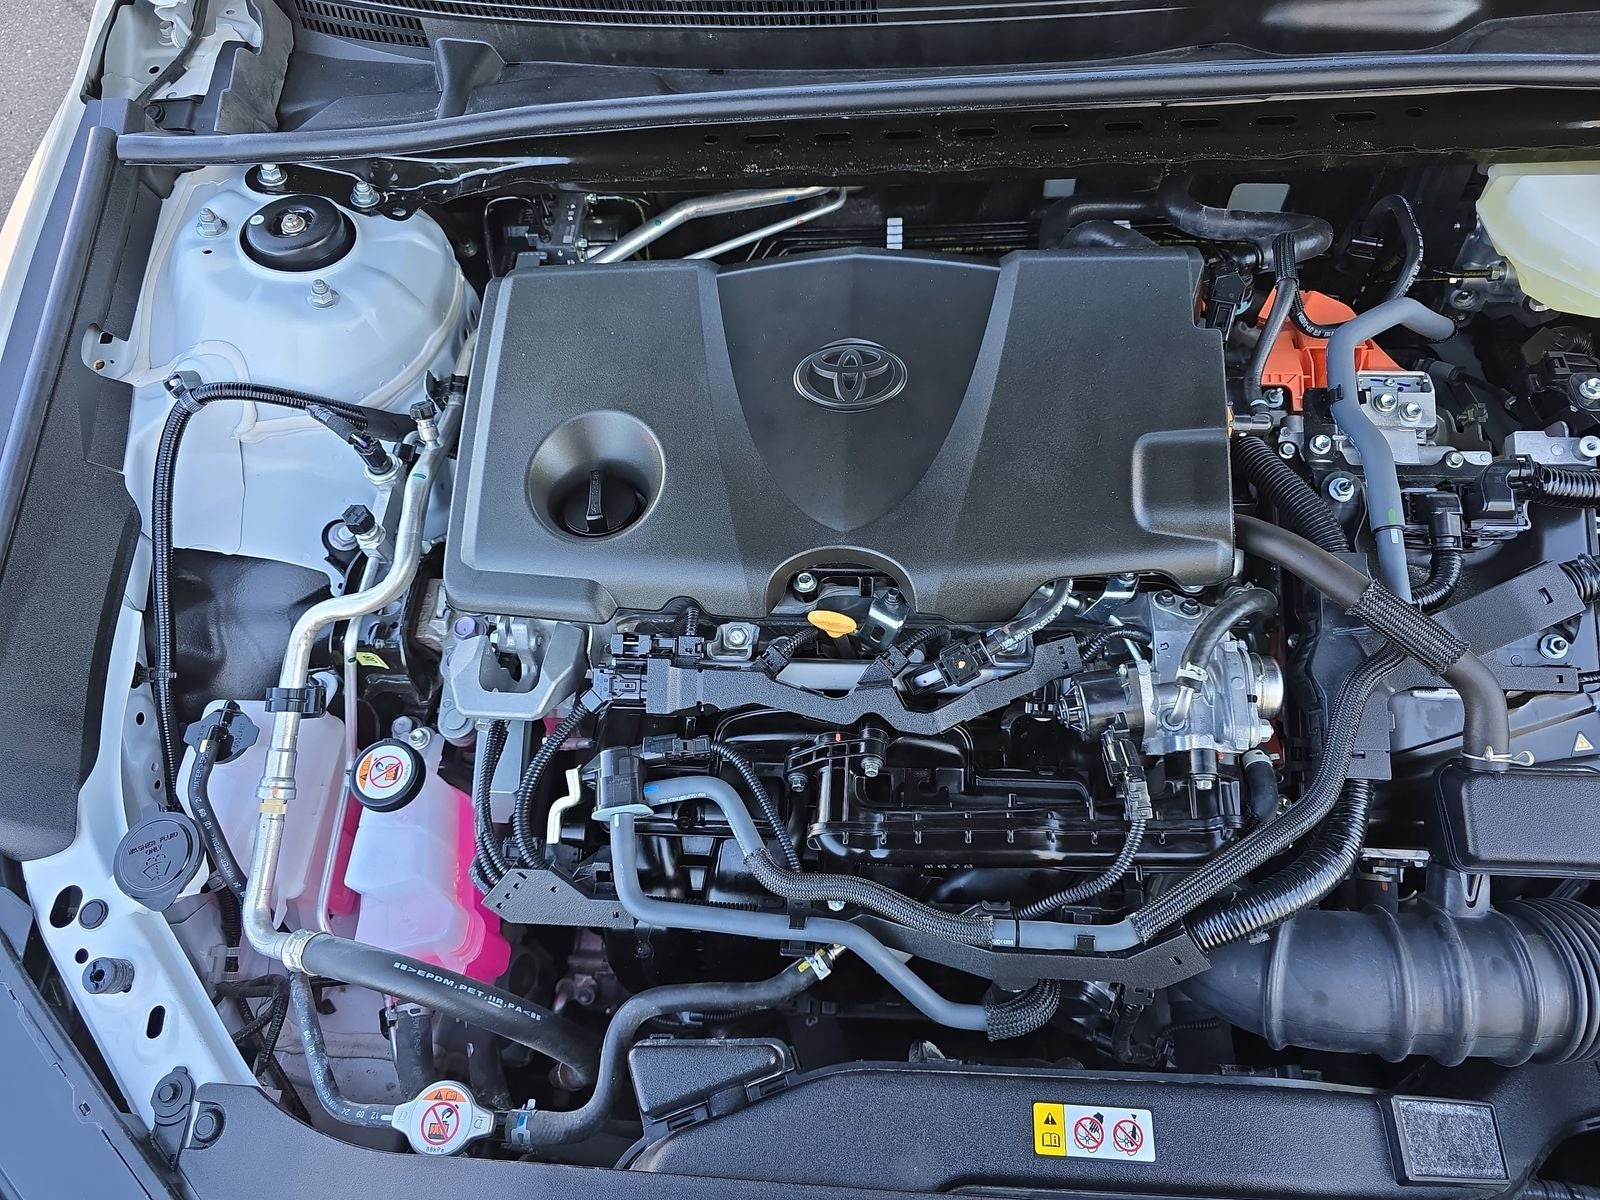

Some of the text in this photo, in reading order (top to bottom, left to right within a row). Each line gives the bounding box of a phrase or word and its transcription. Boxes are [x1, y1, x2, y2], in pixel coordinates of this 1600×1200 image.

[128, 831, 179, 856] WASHER FLUID
[145, 844, 163, 856] ONLY
